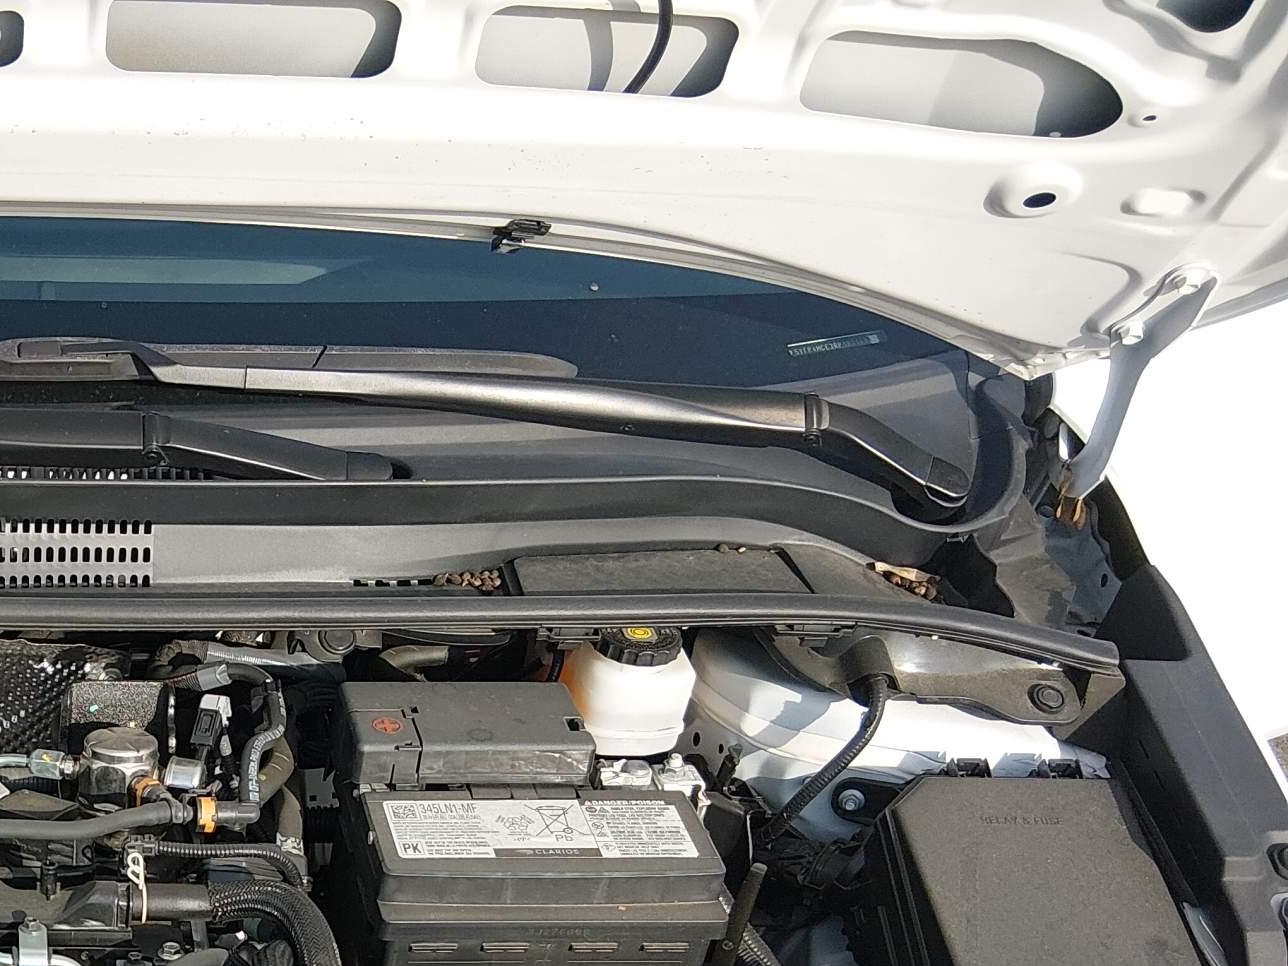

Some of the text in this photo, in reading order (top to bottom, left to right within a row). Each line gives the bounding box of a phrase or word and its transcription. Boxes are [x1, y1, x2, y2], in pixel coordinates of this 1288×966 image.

[420, 802, 478, 814] 345LN1-MF
[554, 834, 574, 842] Pb
[402, 842, 422, 854] PK
